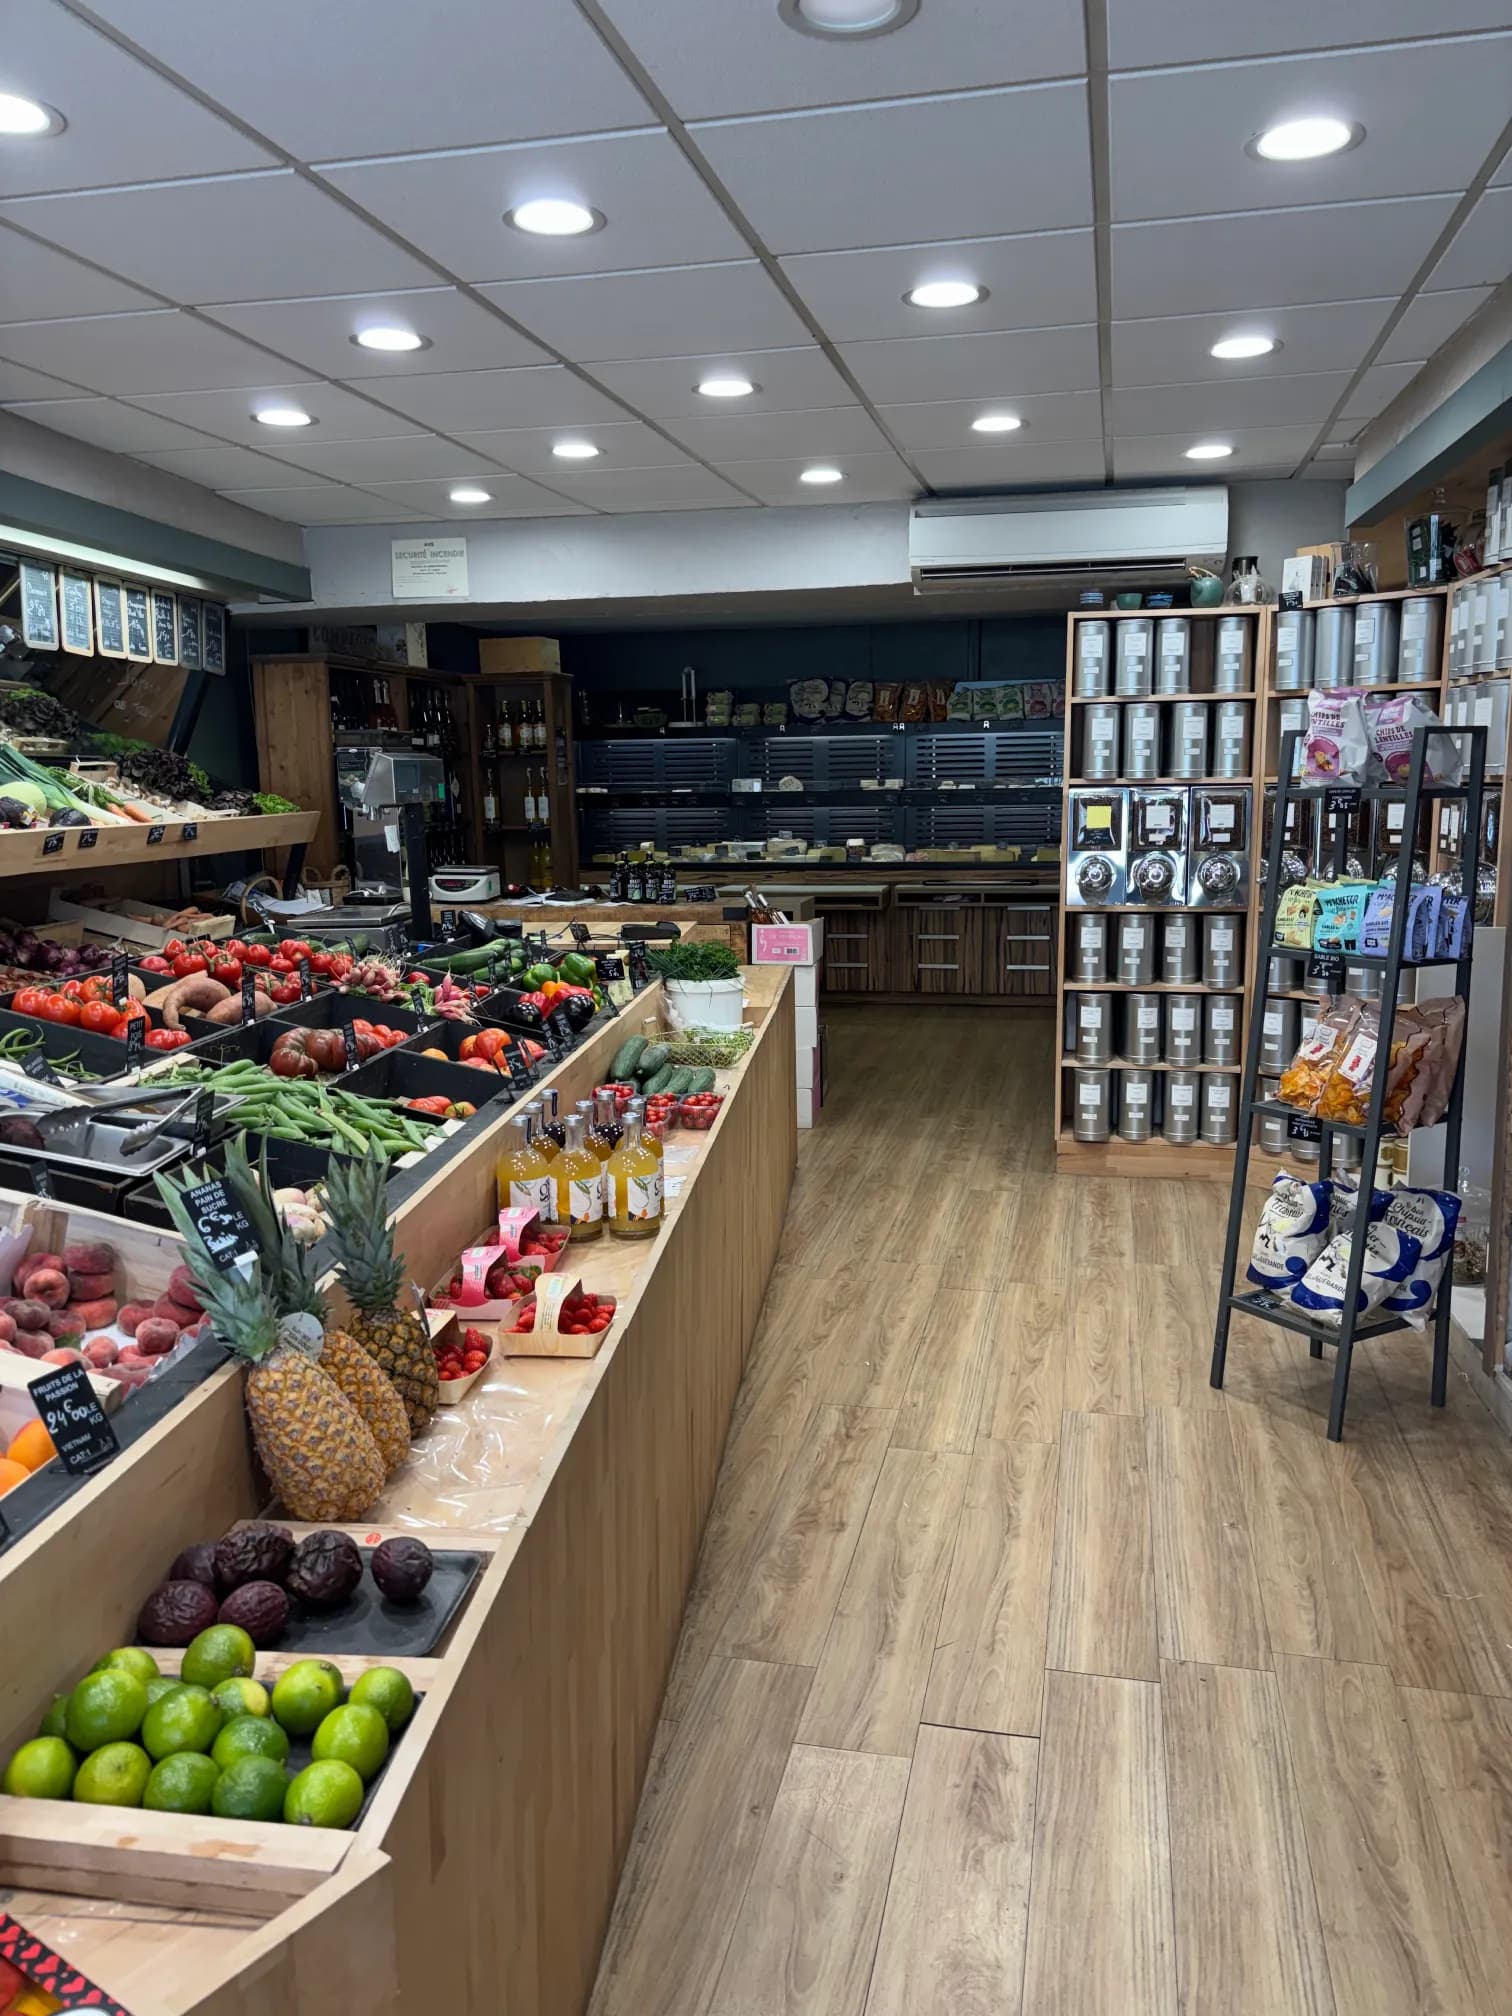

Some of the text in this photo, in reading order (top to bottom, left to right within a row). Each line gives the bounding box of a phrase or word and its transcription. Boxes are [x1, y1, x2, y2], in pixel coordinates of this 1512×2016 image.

[430, 550, 464, 558] INCENDIE
[190, 1181, 222, 1199] ANANAS
[194, 1189, 226, 1208] PAIN DE
[200, 1198, 229, 1215] SUCRE
[232, 1211, 245, 1221] LE
[235, 1219, 249, 1231] KG
[33, 1369, 84, 1397] FRUITS DE LA
[45, 1383, 78, 1402] PASSION
[85, 1402, 98, 1414] LE
[89, 1413, 104, 1425] KG
[61, 1432, 92, 1453] VIETNAM
